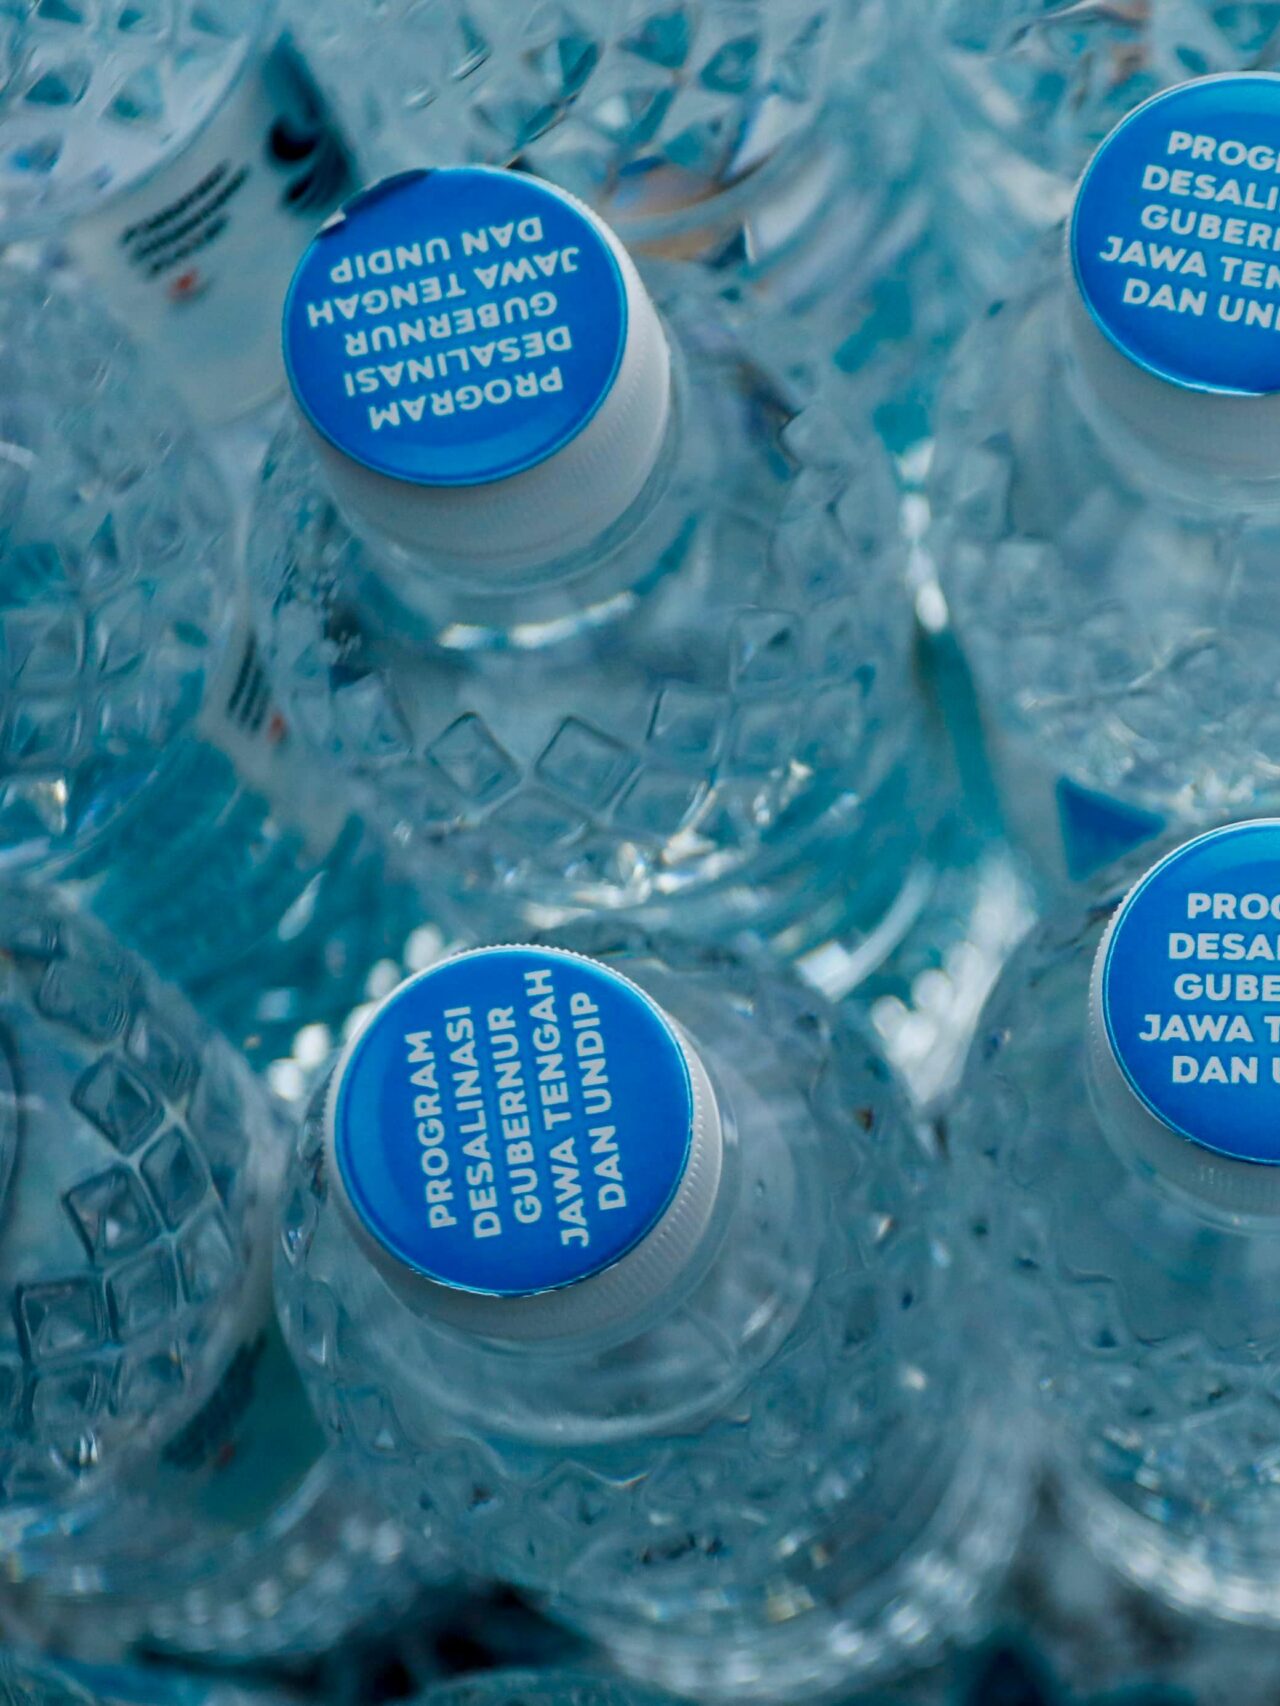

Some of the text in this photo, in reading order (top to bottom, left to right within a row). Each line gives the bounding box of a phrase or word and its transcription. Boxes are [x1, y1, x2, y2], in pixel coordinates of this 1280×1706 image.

[330, 217, 543, 283] DAN UNDIP
[1100, 236, 1207, 277] JAWA
[307, 247, 579, 327] JAWA TENGAH
[1123, 278, 1207, 316] DAN
[345, 291, 558, 356] GUBERNUR
[345, 326, 572, 397] DESALINASI
[369, 366, 563, 430] PROGRAM
[1139, 1014, 1254, 1042] JAWA
[570, 992, 626, 1210] DAN UNDIP
[1172, 1055, 1258, 1084] DAN
[405, 1030, 457, 1228] PROGRAM
[443, 1006, 501, 1238] DESALINASI
[487, 1006, 542, 1224] GUBERNUR
[524, 969, 589, 1247] JAWA TENGAH
